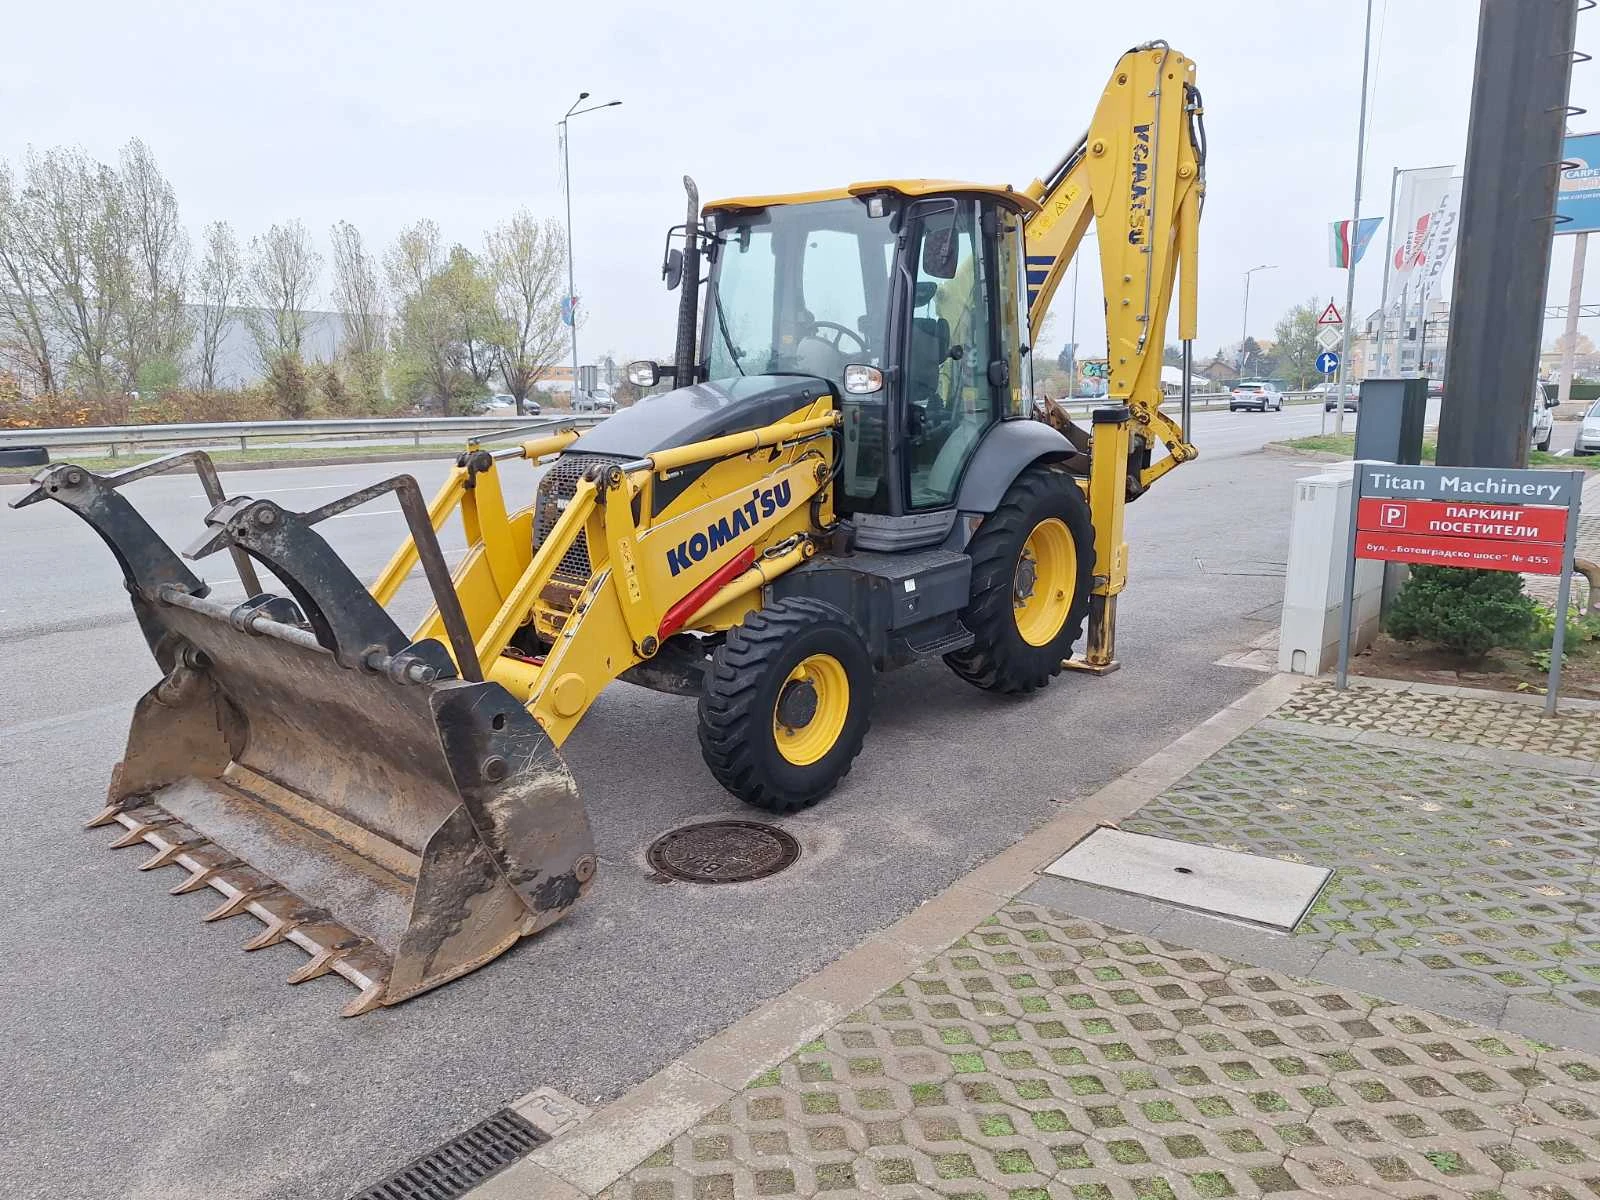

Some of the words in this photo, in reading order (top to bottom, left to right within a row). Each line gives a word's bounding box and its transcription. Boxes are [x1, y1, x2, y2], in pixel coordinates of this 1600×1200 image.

[1566, 168, 1600, 179] CARPE
[1369, 473, 1425, 490] Titan
[1440, 476, 1561, 501] Machinery
[1387, 508, 1401, 524] P
[1446, 507, 1524, 521] ПАРКИНГ
[666, 479, 792, 577] KOMATSU
[1429, 521, 1538, 537] ПОСЕТИТЕЛИ
[1527, 555, 1550, 564] 455
